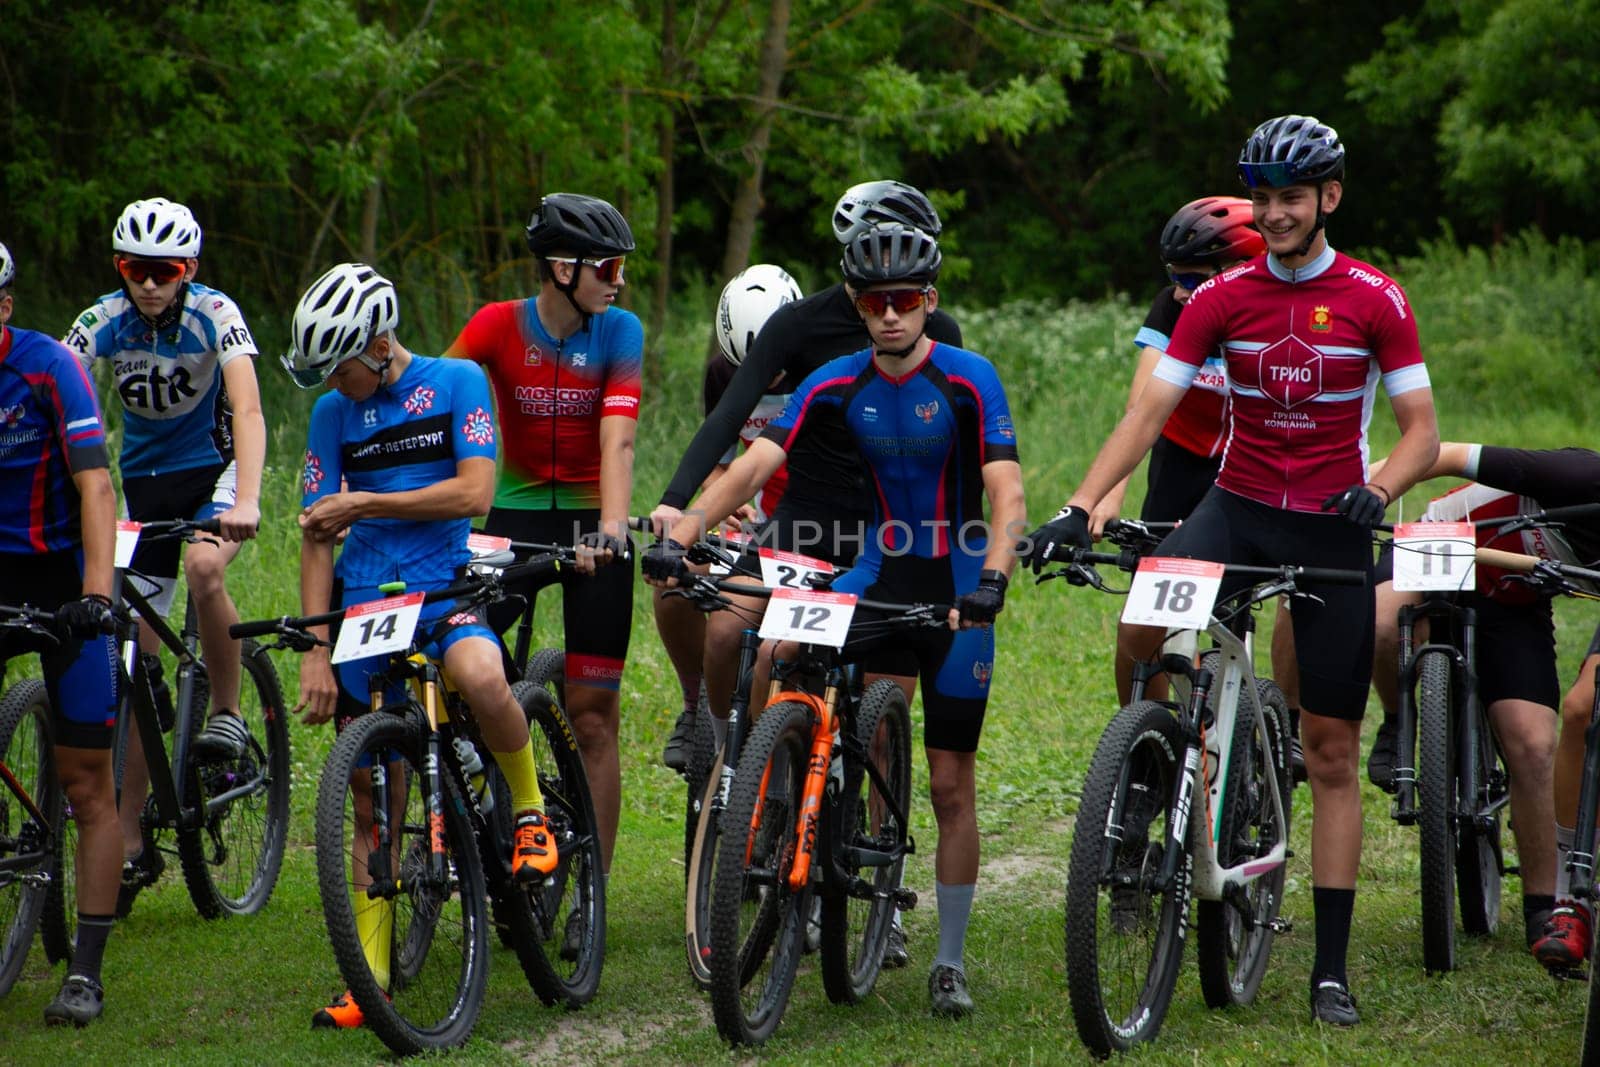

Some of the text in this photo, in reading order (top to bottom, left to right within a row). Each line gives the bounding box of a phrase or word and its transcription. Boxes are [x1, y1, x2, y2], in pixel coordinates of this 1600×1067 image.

[1348, 266, 1384, 287] ТРИО
[1269, 366, 1312, 383] ТРИО
[515, 385, 601, 402] MOSCOW
[521, 402, 594, 417] REGION
[1273, 411, 1310, 421] ГРУППА
[1264, 419, 1317, 430] КОМПАНИЙ
[1417, 544, 1451, 575] 11
[1153, 579, 1197, 612] 18
[789, 605, 831, 631] 12
[360, 614, 397, 645] 14
[1177, 852, 1193, 940] MAXXIS
